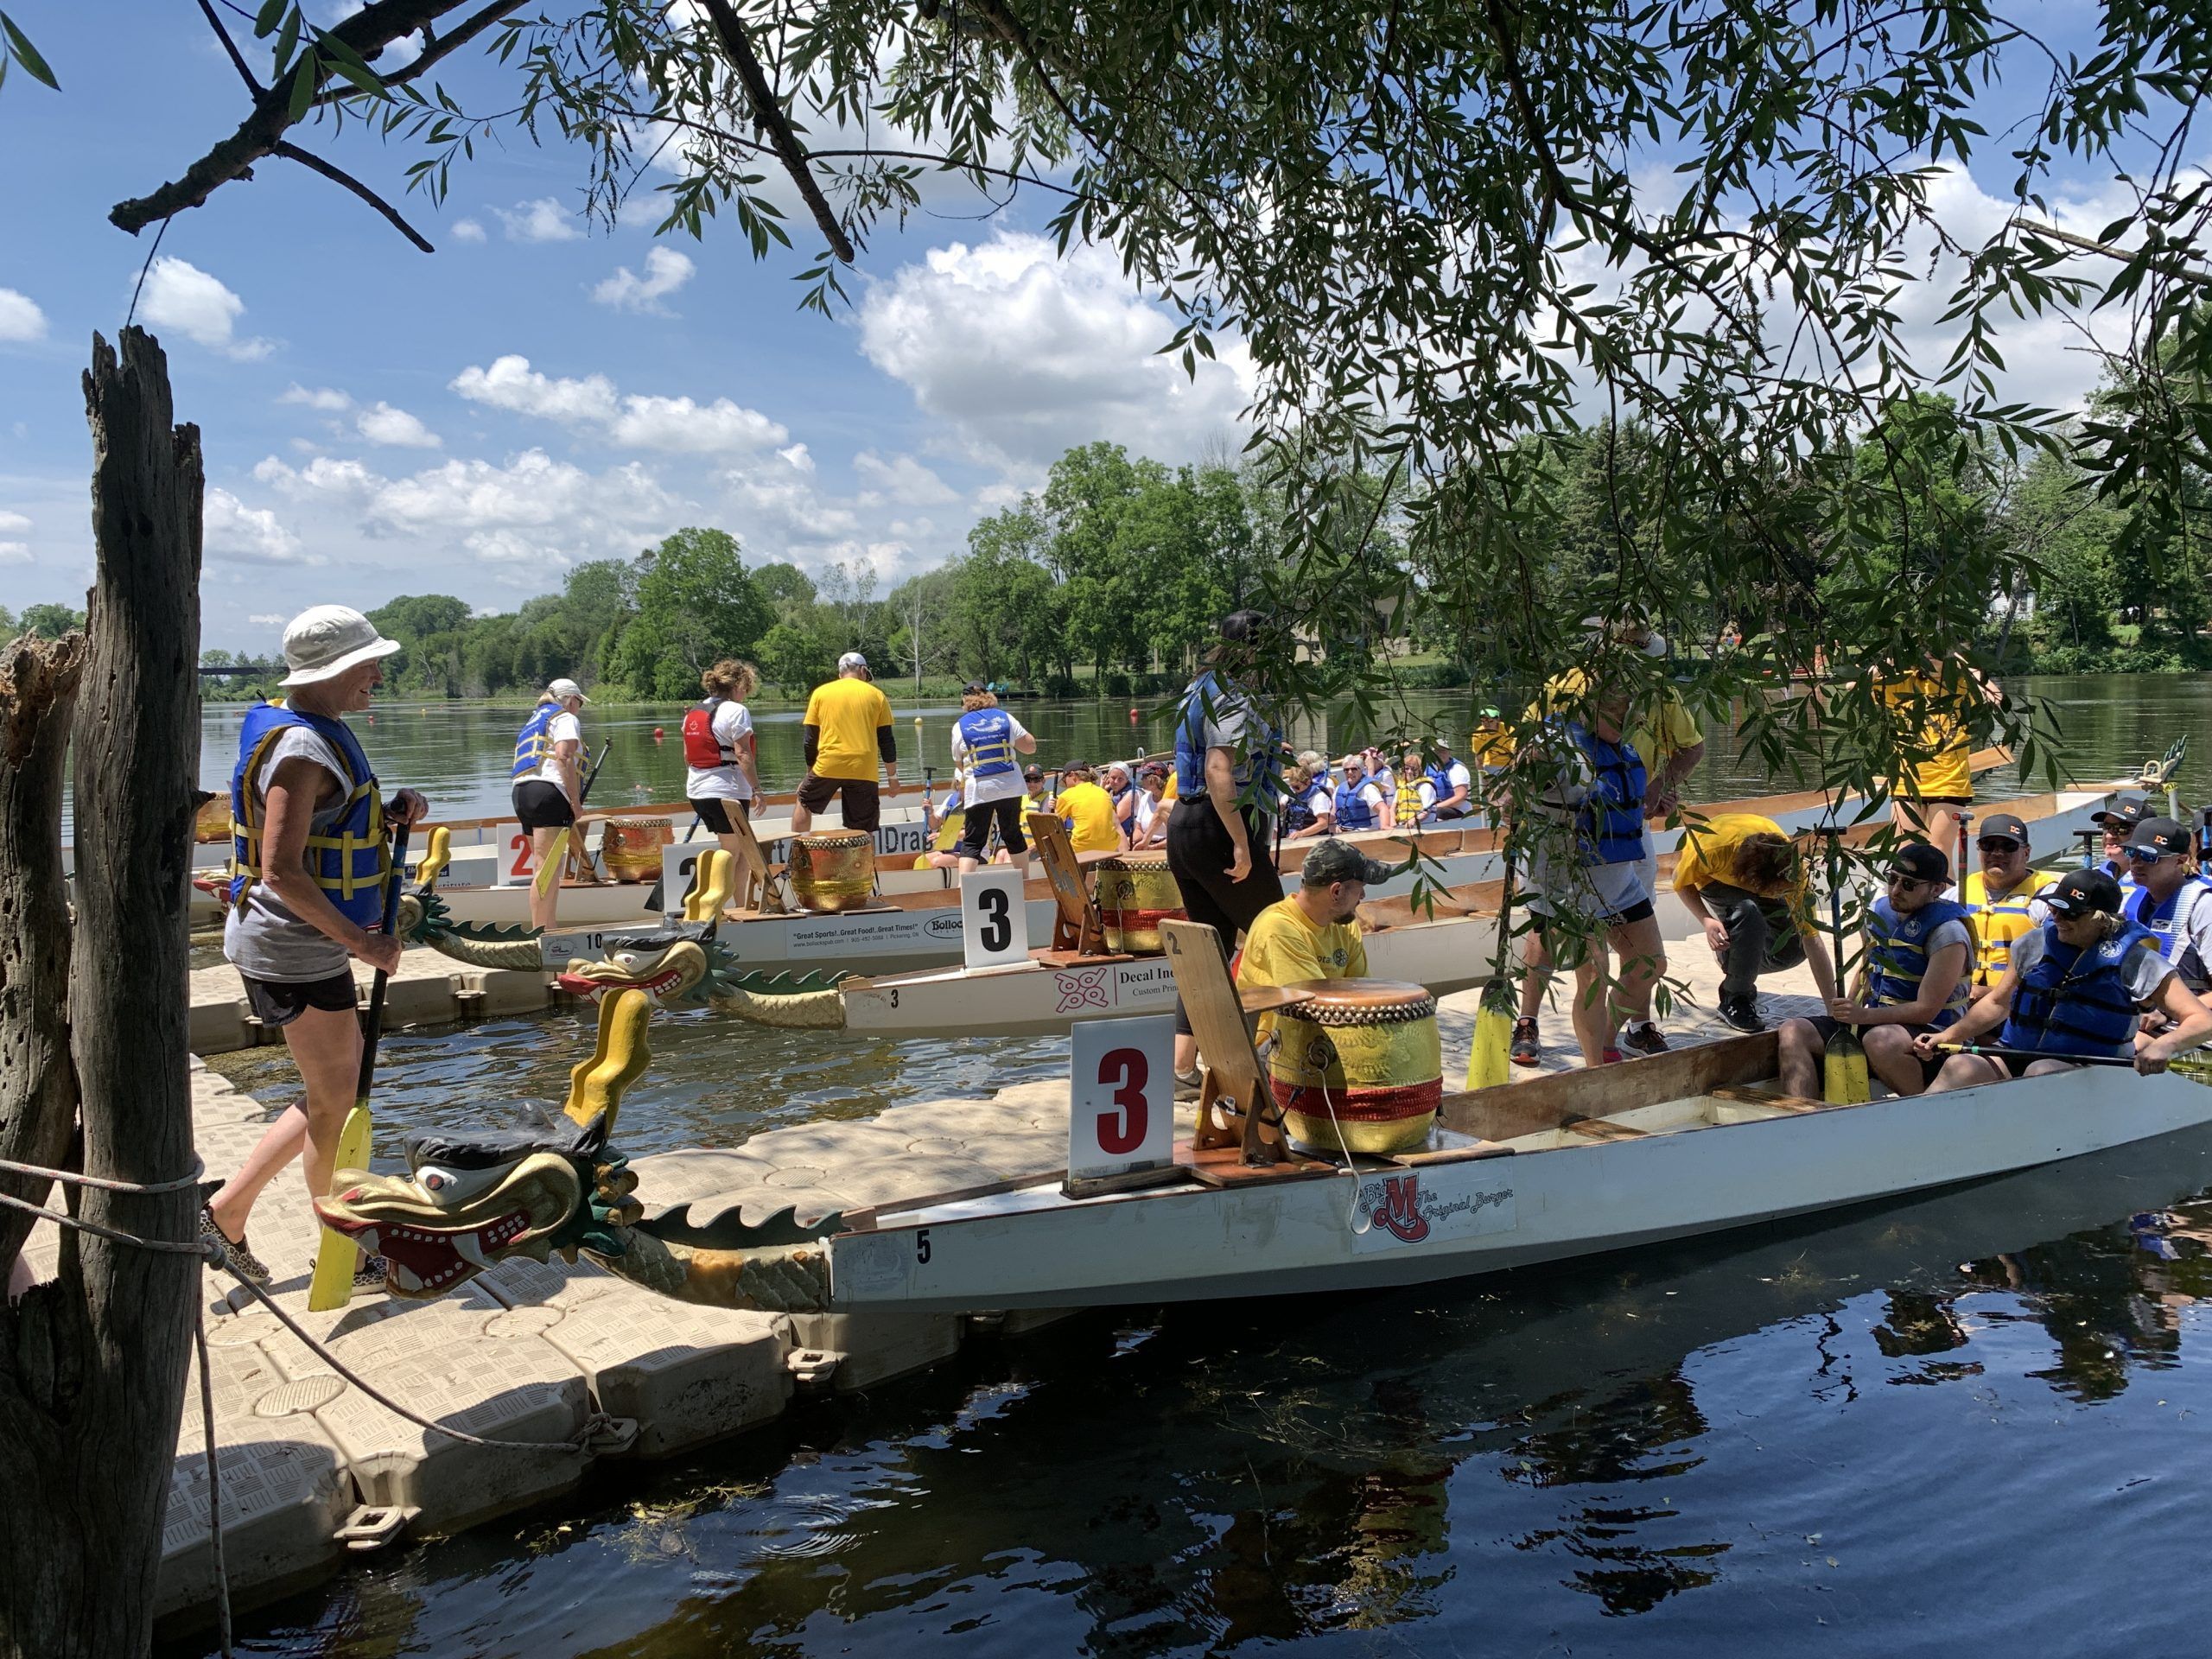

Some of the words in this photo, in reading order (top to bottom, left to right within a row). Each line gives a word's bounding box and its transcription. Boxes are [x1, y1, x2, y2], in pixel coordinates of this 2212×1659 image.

[510, 834, 534, 876] 2
[2070, 888, 2085, 900] DC
[978, 888, 1012, 952] 3
[587, 933, 603, 950] 10
[1166, 931, 1183, 955] 2
[1120, 969, 1154, 984] Decal
[891, 988, 899, 1009] 3
[1132, 987, 1161, 997] Custom
[1096, 1047, 1148, 1155] 3
[1372, 1172, 1430, 1243] M
[1414, 1189, 1439, 1209] The
[1422, 1195, 1471, 1222] Original
[1470, 1187, 1514, 1214] Burger
[917, 1229, 931, 1265] 5
